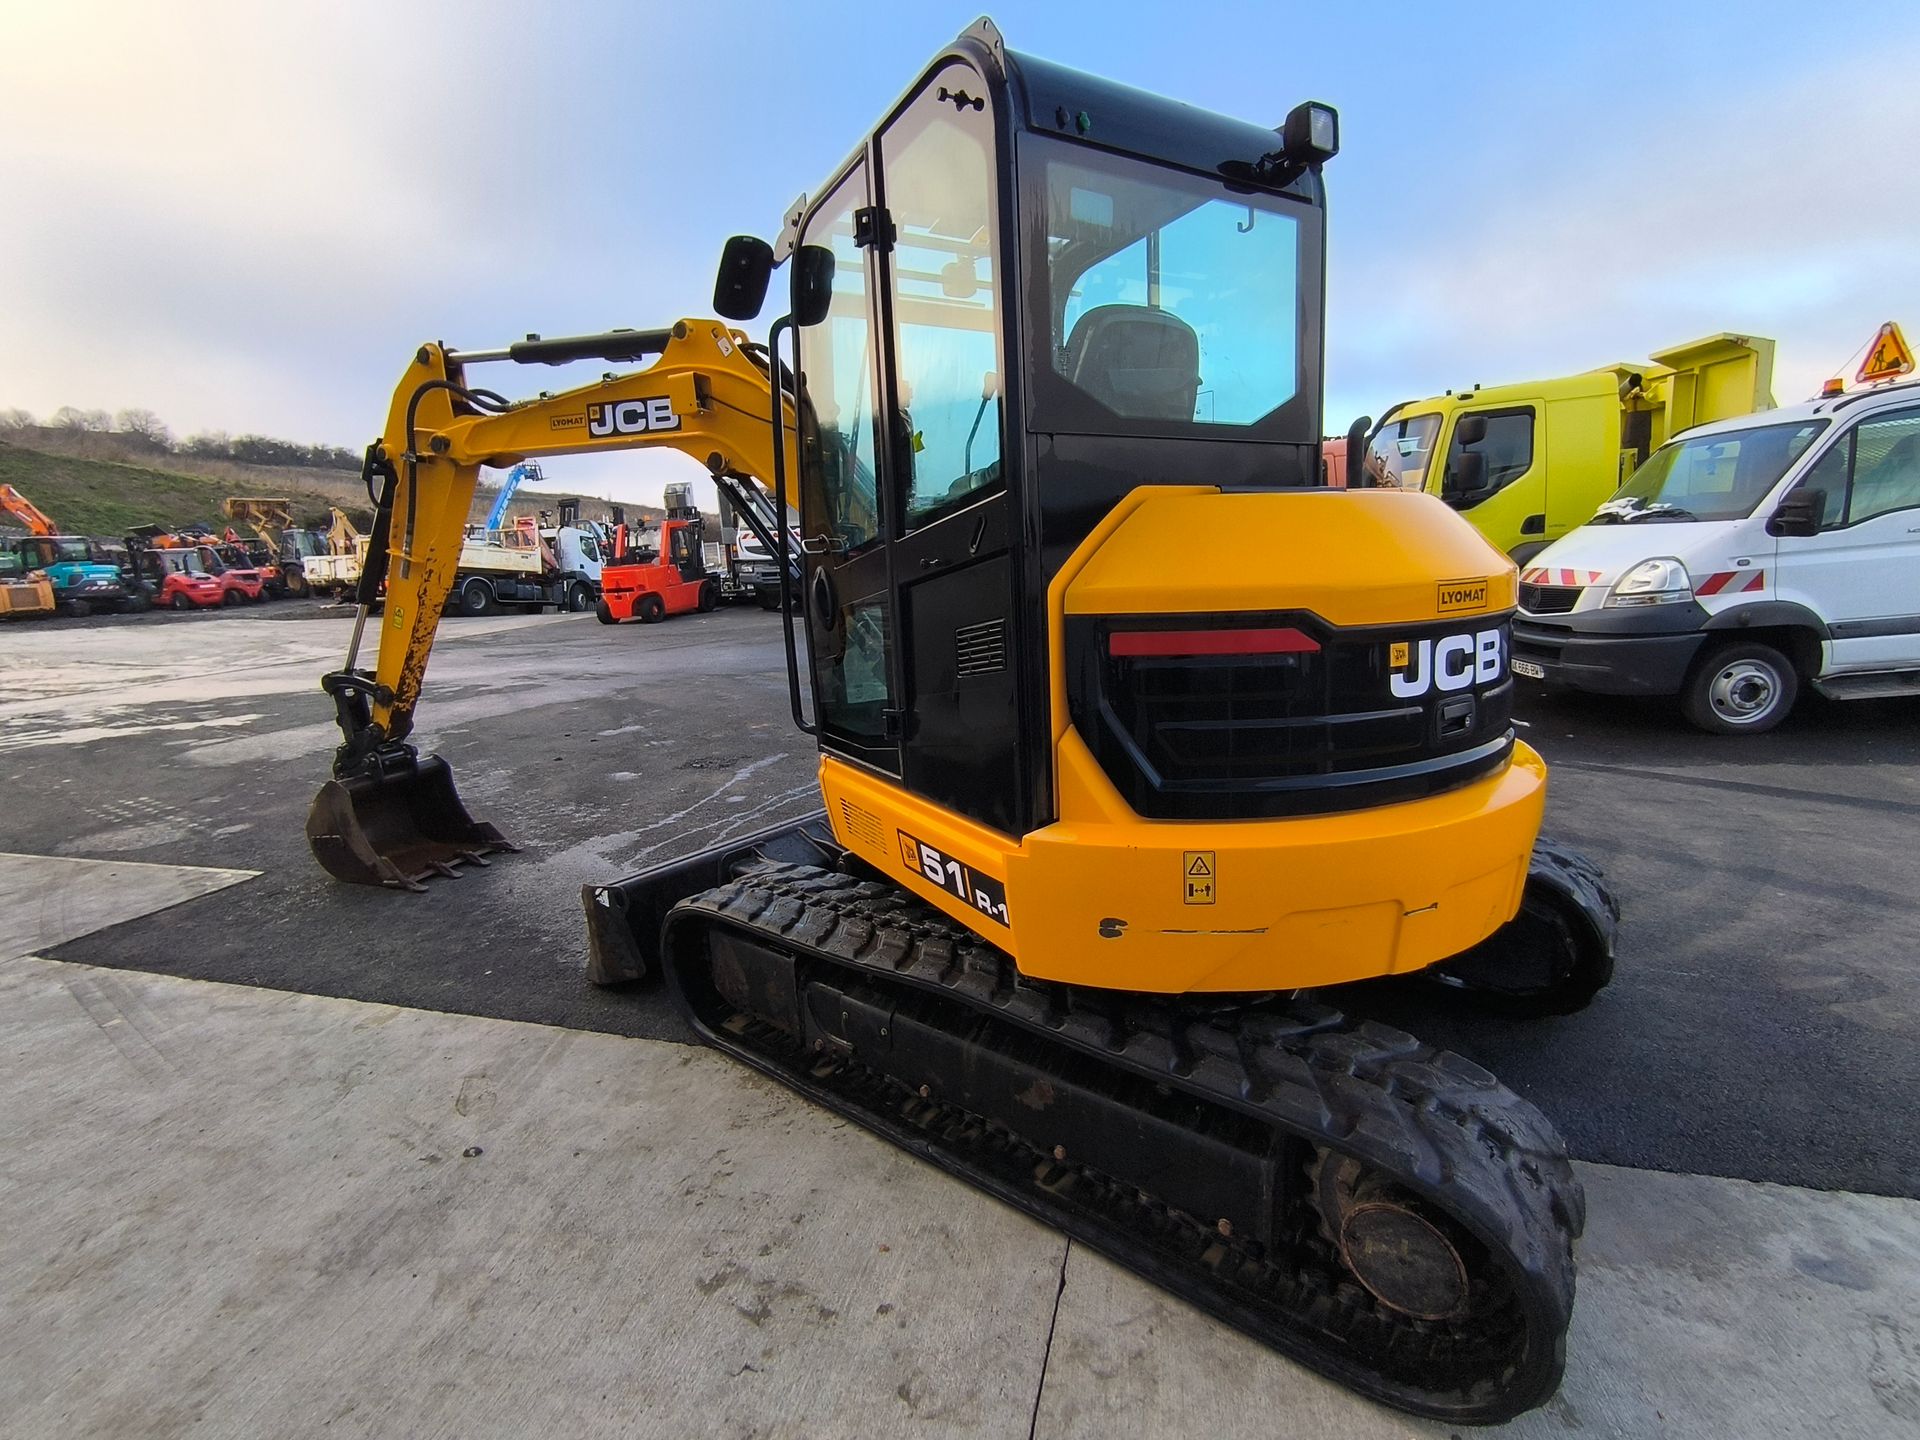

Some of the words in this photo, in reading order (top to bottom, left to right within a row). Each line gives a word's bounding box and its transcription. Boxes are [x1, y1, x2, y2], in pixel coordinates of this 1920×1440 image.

[552, 416, 584, 428] LYOMAT
[590, 398, 679, 436] JCB
[1441, 588, 1486, 605] LYOMAT
[1390, 629, 1500, 698] JCB
[920, 843, 966, 898] 51
[975, 888, 1010, 925] R-1
